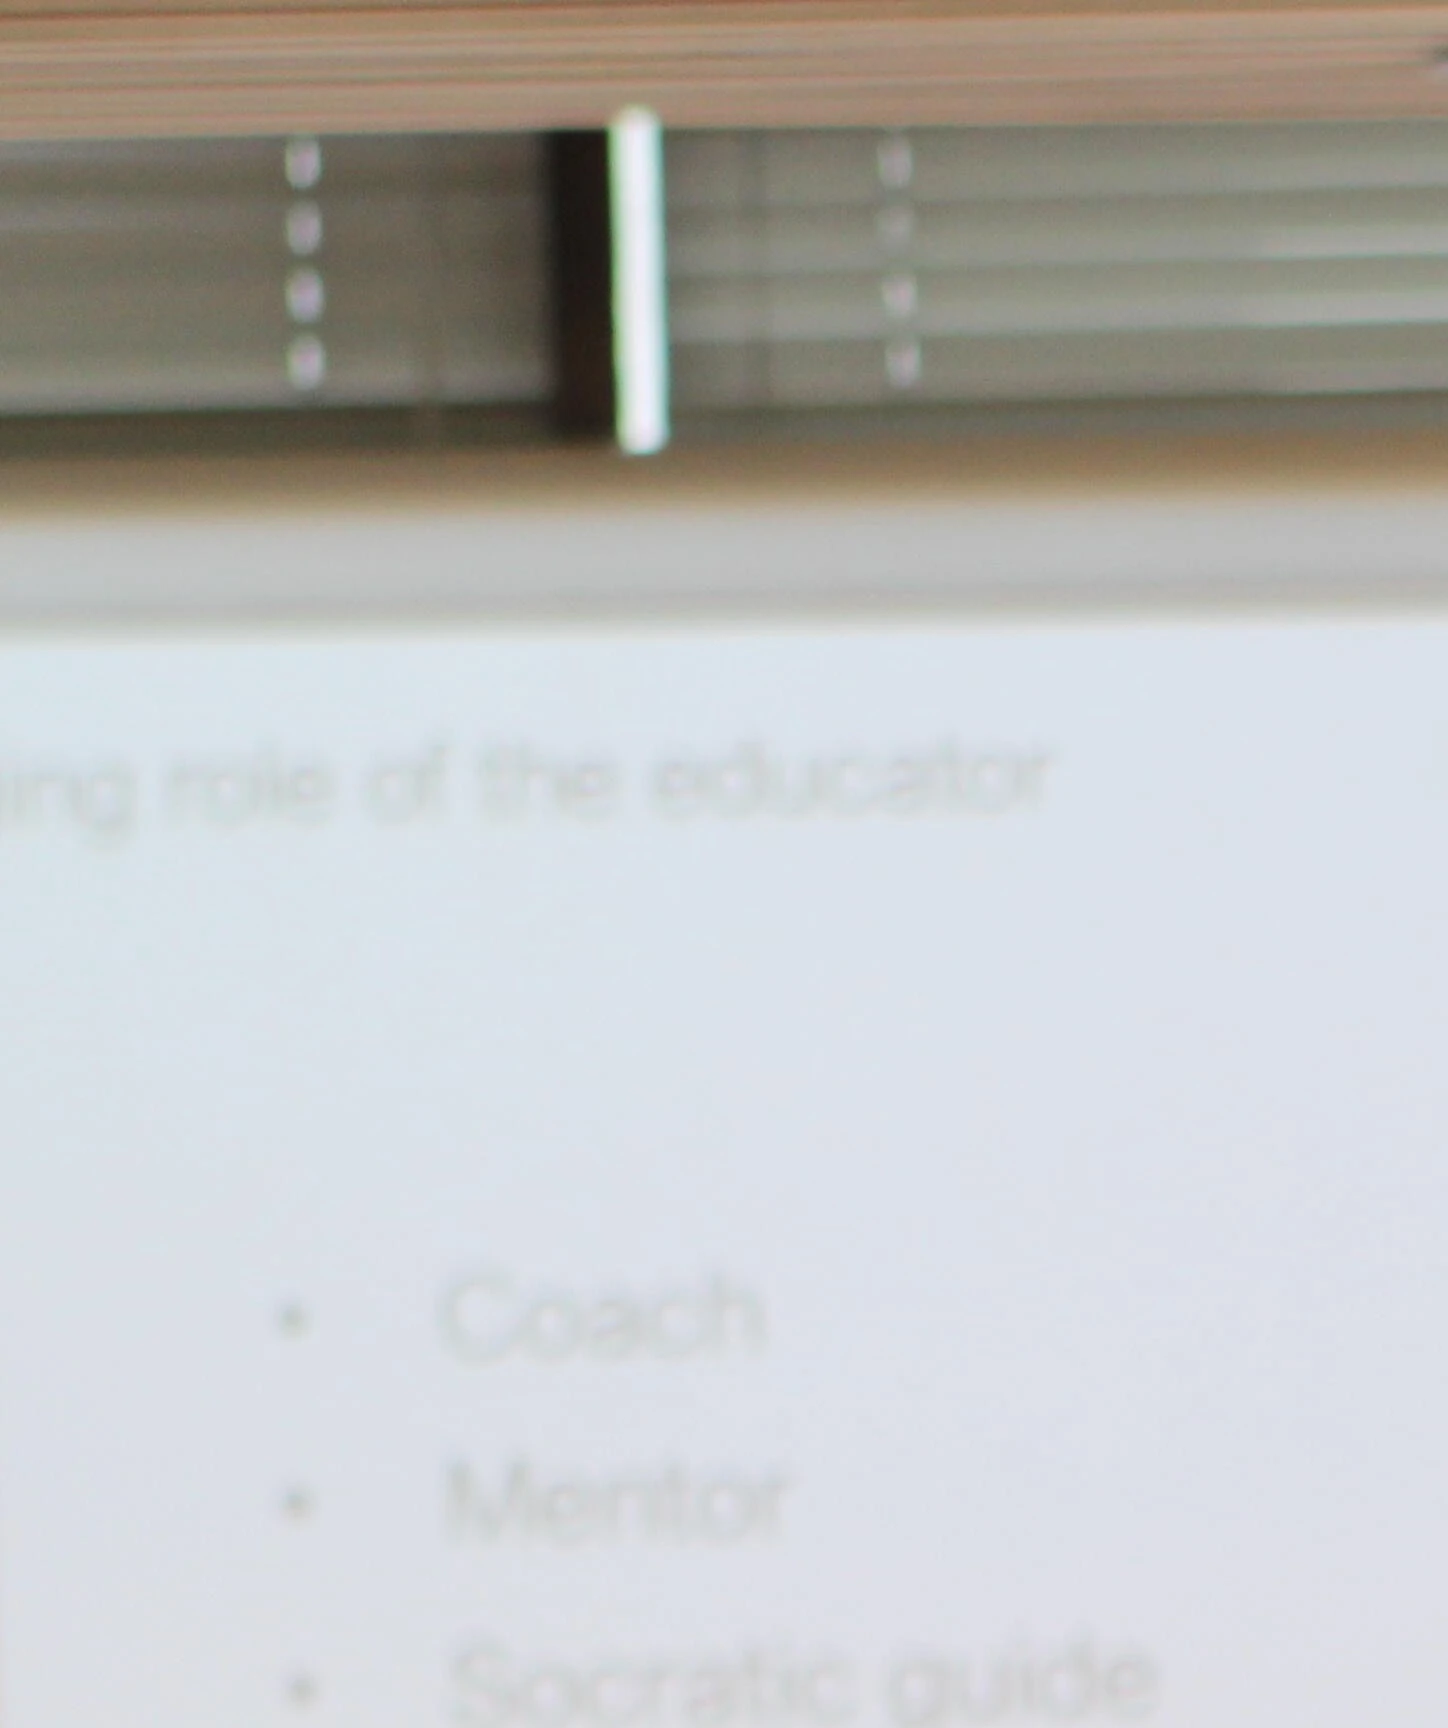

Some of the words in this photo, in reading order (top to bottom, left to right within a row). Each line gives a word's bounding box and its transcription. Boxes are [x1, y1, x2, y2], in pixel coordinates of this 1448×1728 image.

[169, 741, 333, 821] role
[366, 731, 449, 821] of
[480, 738, 617, 821] the
[649, 735, 1055, 817] educator
[440, 1265, 766, 1361] Coach
[447, 1452, 794, 1542] Mentor
[447, 1635, 856, 1728] Socratic
